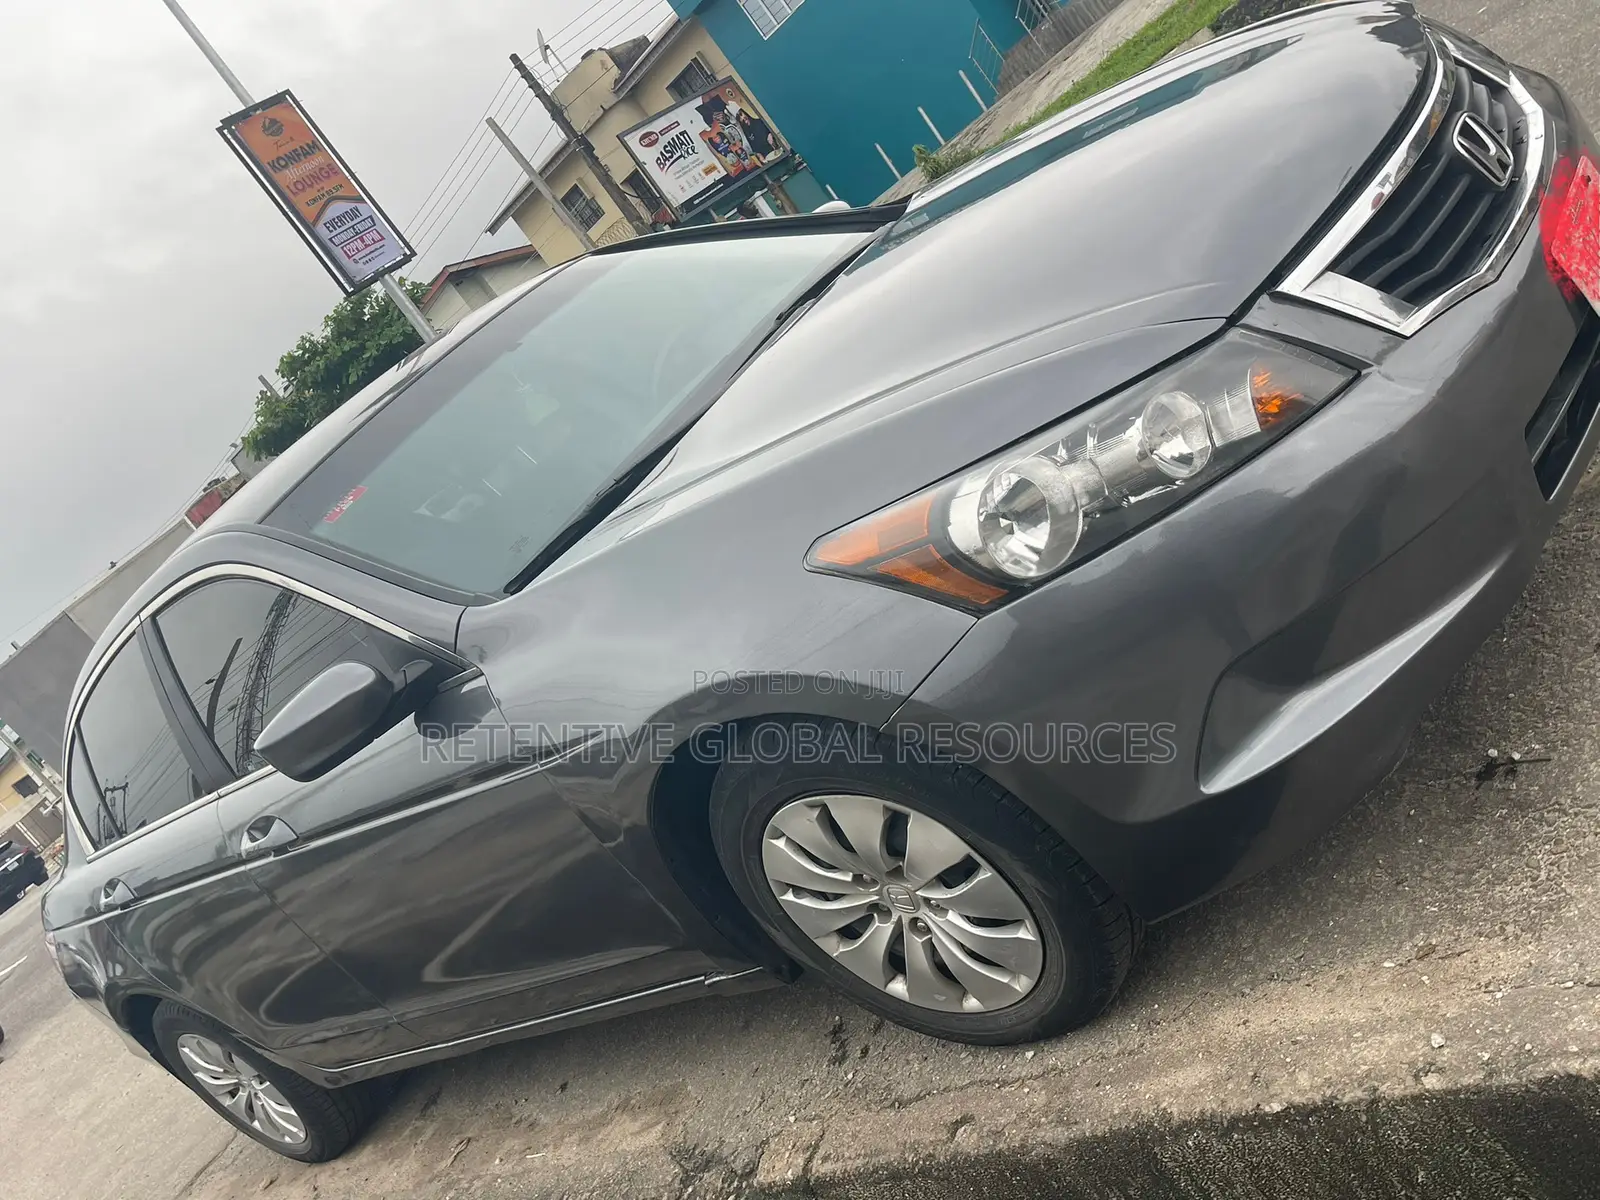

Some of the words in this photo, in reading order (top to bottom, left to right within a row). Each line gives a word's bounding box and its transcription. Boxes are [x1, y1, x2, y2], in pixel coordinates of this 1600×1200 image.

[267, 140, 323, 173] KONFAM
[655, 129, 695, 173] BASMATI
[285, 156, 325, 181] Afternoon
[286, 163, 340, 198] LOUNGE
[323, 205, 363, 234] EVERYDAY
